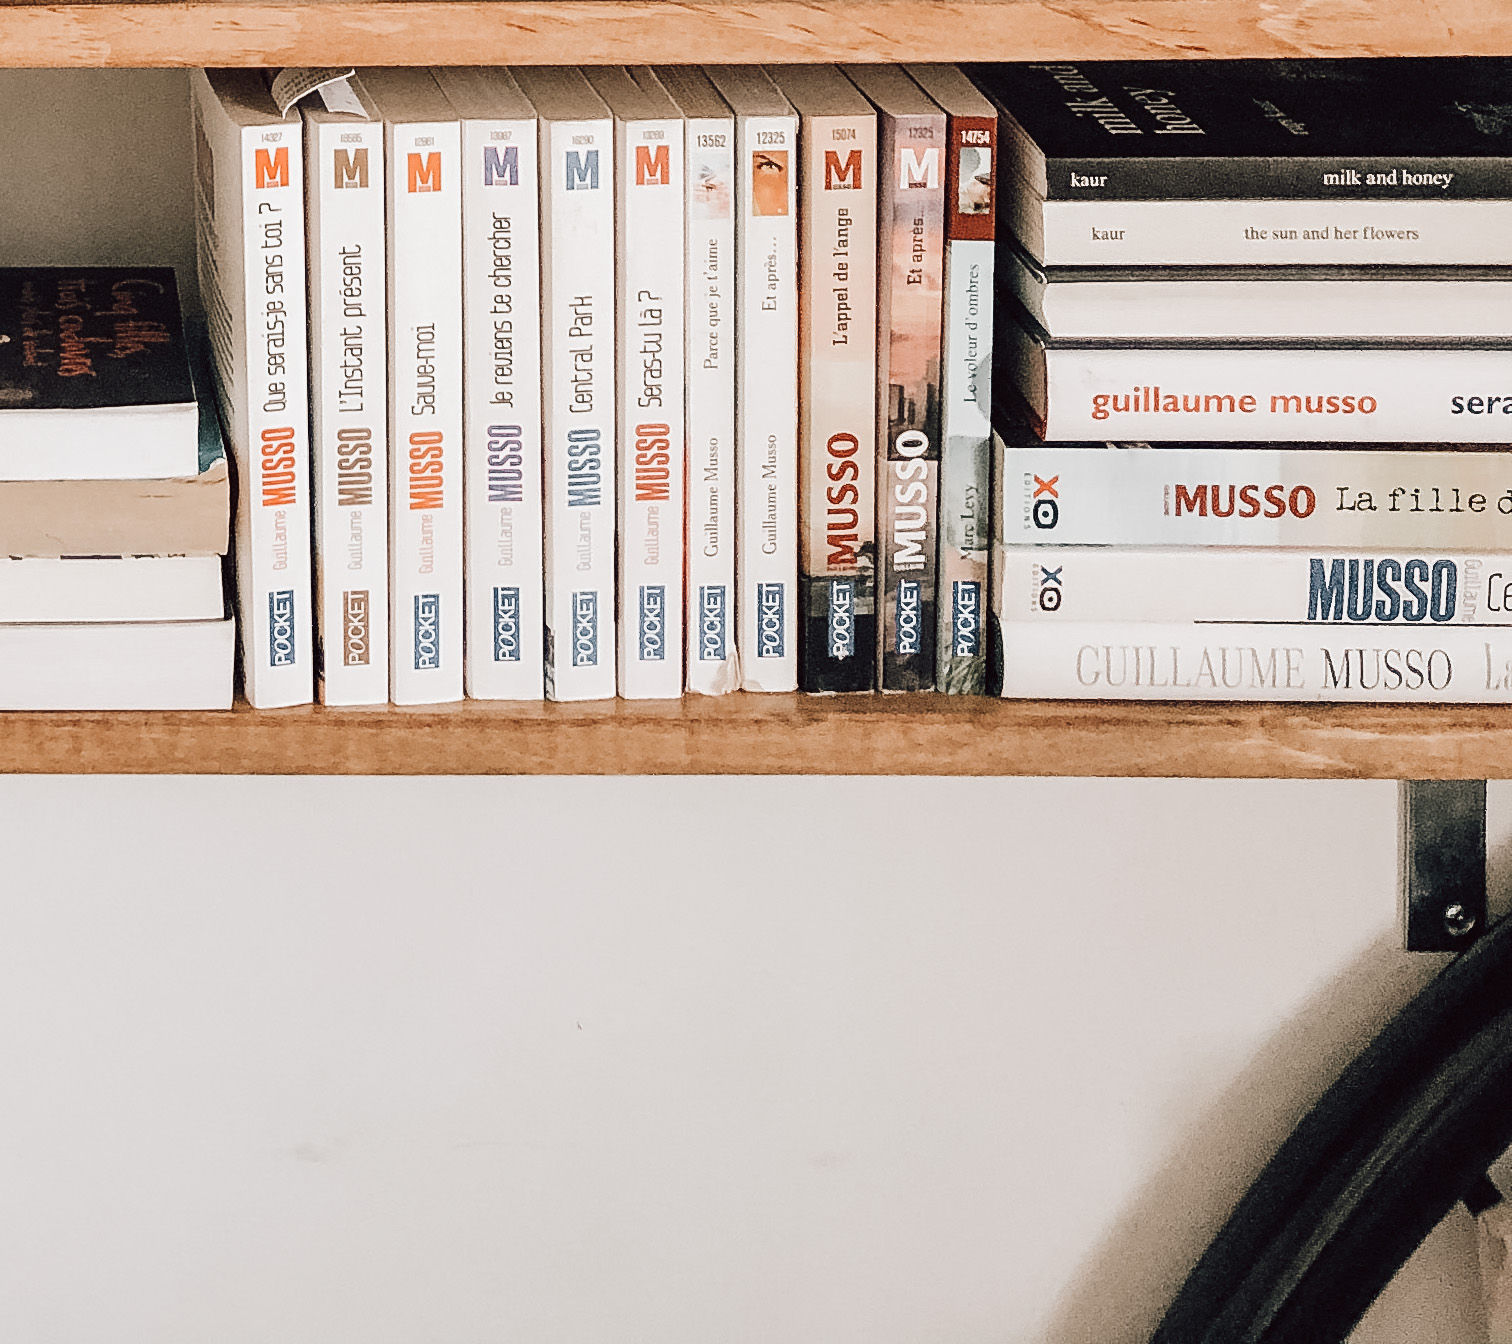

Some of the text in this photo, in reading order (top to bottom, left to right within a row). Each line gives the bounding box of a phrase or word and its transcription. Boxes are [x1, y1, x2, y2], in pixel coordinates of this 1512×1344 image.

[696, 135, 726, 148] 13562
[1070, 170, 1454, 190] kaur milk and honey
[1091, 226, 1420, 240] kaur the sun and her flowers
[832, 263, 848, 286] de
[411, 322, 435, 416] Sauve-moi
[569, 294, 593, 414] Central Park
[1091, 385, 1378, 421] guillaume musso
[261, 427, 296, 506] MUSSO
[826, 432, 859, 567] MUSSO
[1174, 484, 1488, 518] MUSSO La fille
[1307, 558, 1459, 622] MUSSO
[274, 590, 294, 664] POCKET
[1076, 644, 1453, 692] GUILLAUME MUSSO
